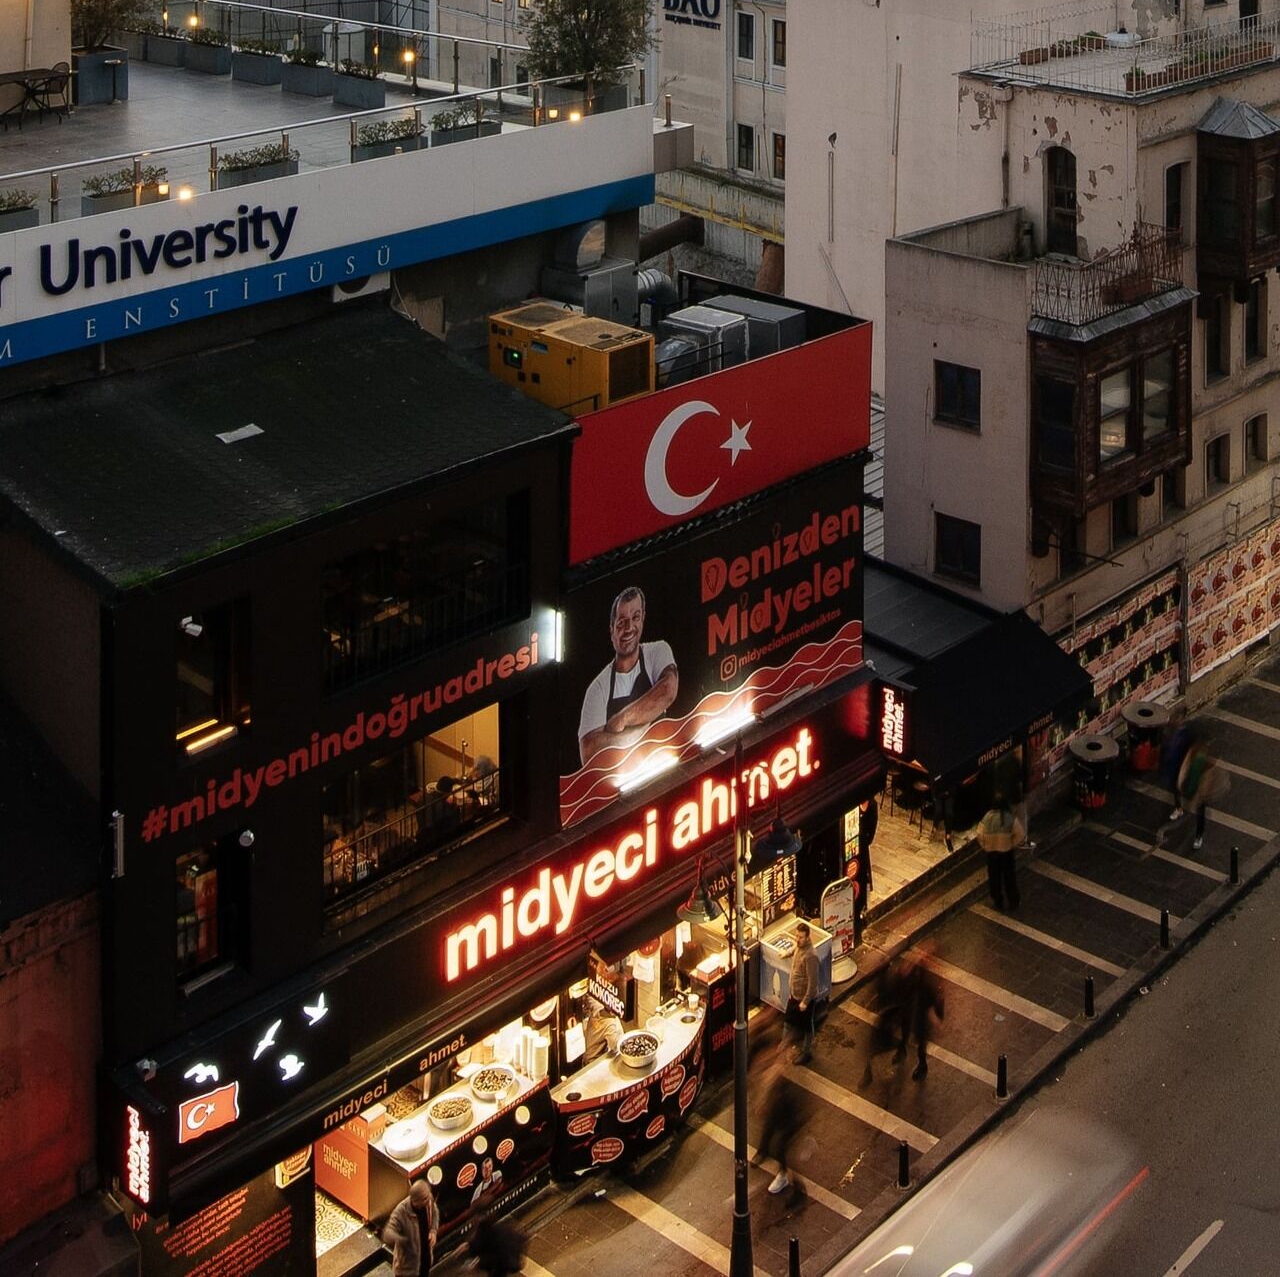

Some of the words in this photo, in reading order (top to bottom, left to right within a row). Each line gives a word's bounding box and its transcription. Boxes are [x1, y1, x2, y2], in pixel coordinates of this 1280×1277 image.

[39, 204, 299, 297] University
[85, 245, 393, 340] ENSTİTÜSÜ
[701, 504, 860, 604] Denizden
[708, 557, 856, 656] Midyeler
[141, 632, 539, 843] #midyenindoğruadresi
[882, 687, 895, 750] midyeci
[977, 738, 1013, 768] midyeci
[445, 808, 658, 983] midyeci
[595, 973, 619, 996] KUZU
[323, 1079, 388, 1129] midyeci
[323, 1143, 358, 1173] midyeci
